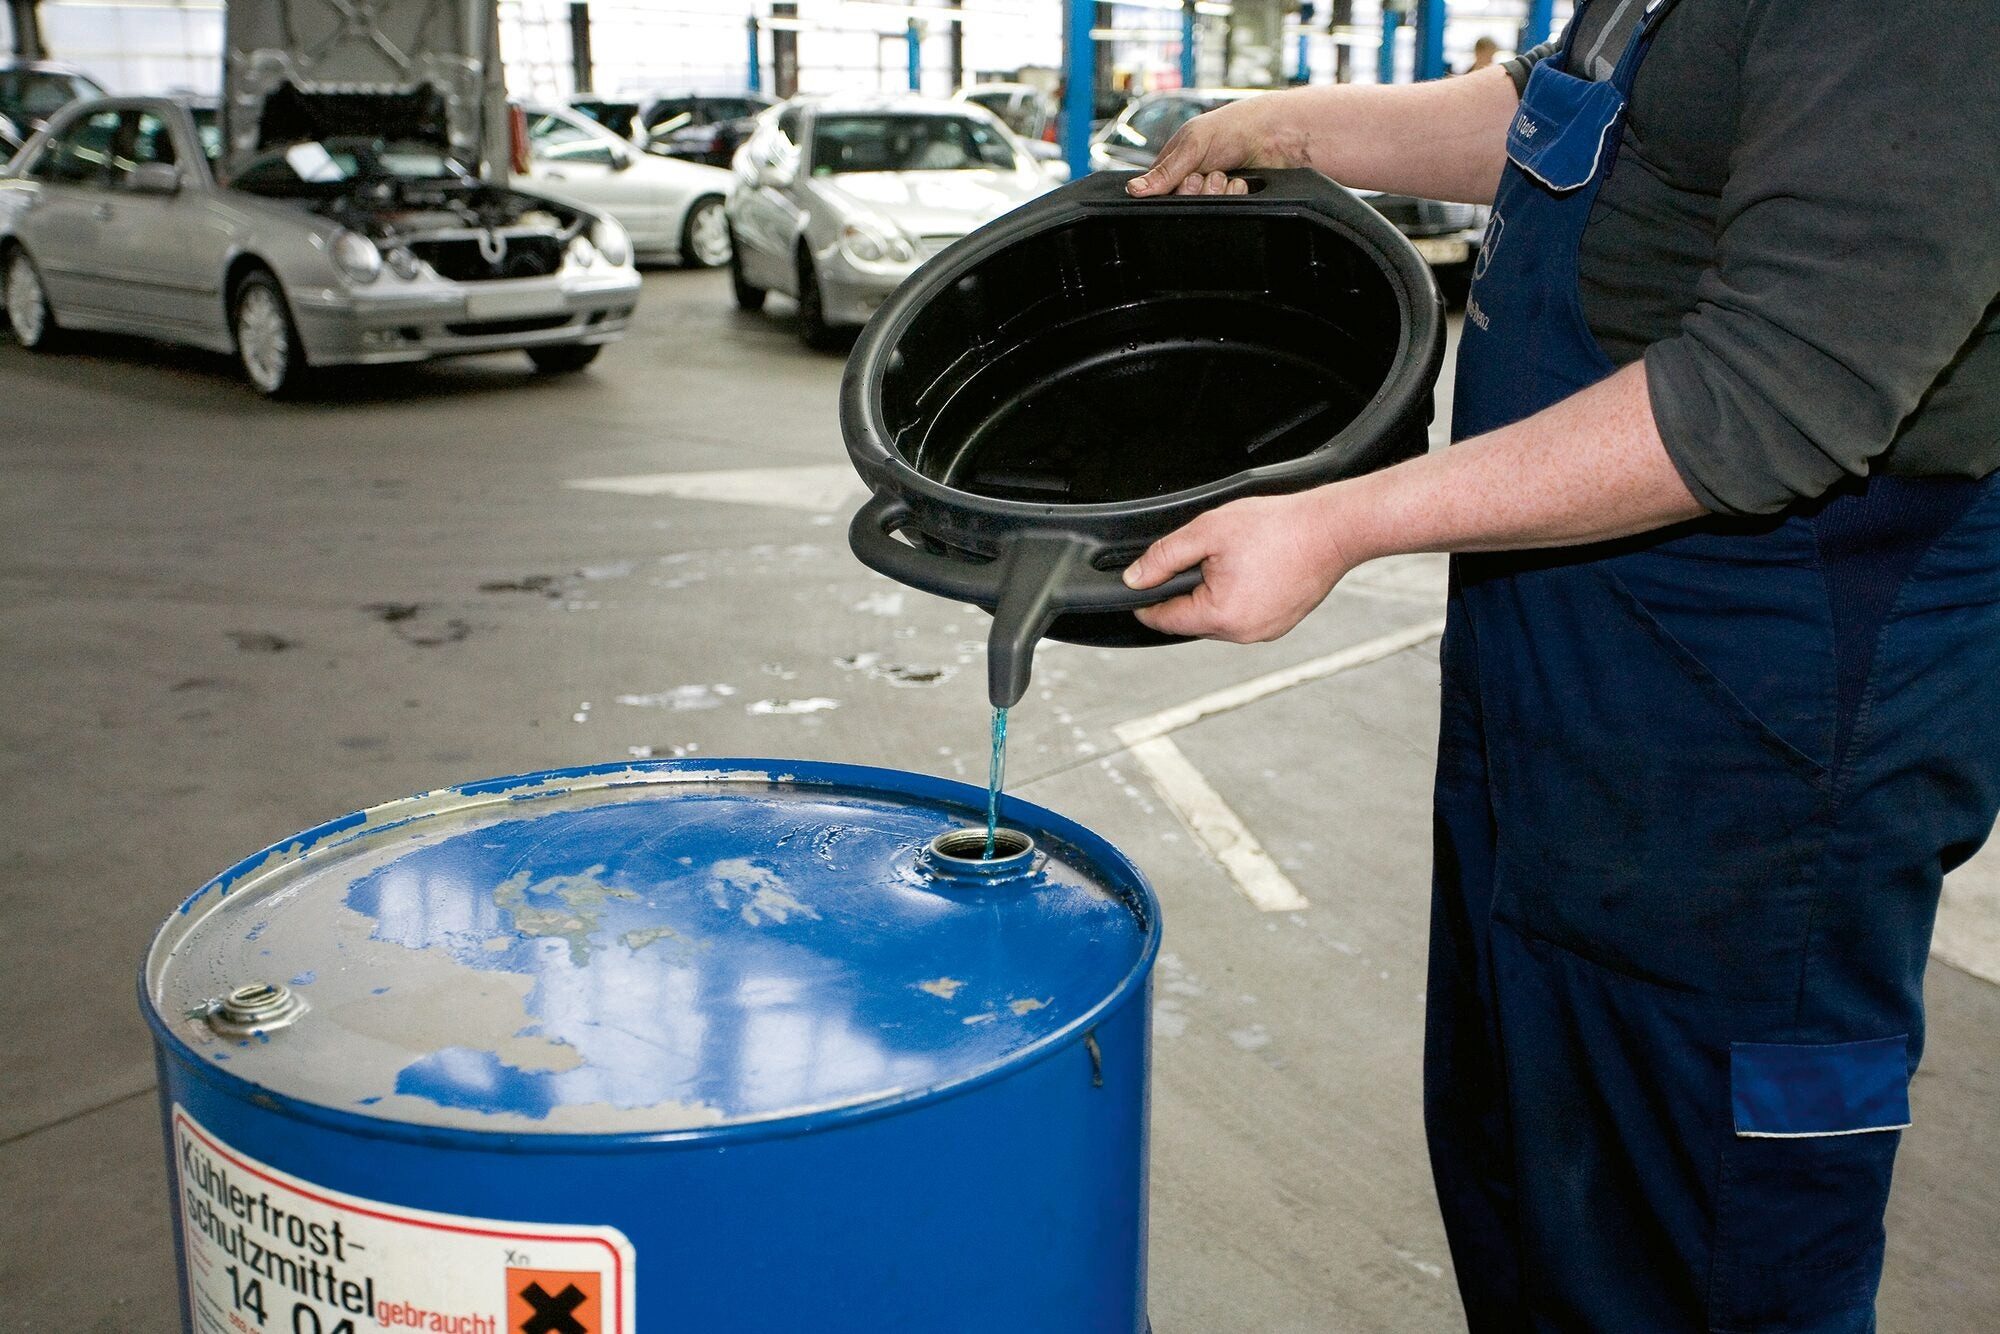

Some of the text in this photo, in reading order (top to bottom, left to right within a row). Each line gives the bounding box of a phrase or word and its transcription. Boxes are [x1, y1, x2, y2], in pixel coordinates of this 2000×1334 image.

[181, 1131, 365, 1263] Kühlerfrost-
[187, 1188, 375, 1318] schutzmittel
[376, 1300, 496, 1334] gebraucht
[225, 1265, 268, 1326] 14
[504, 1249, 531, 1266] Xn
